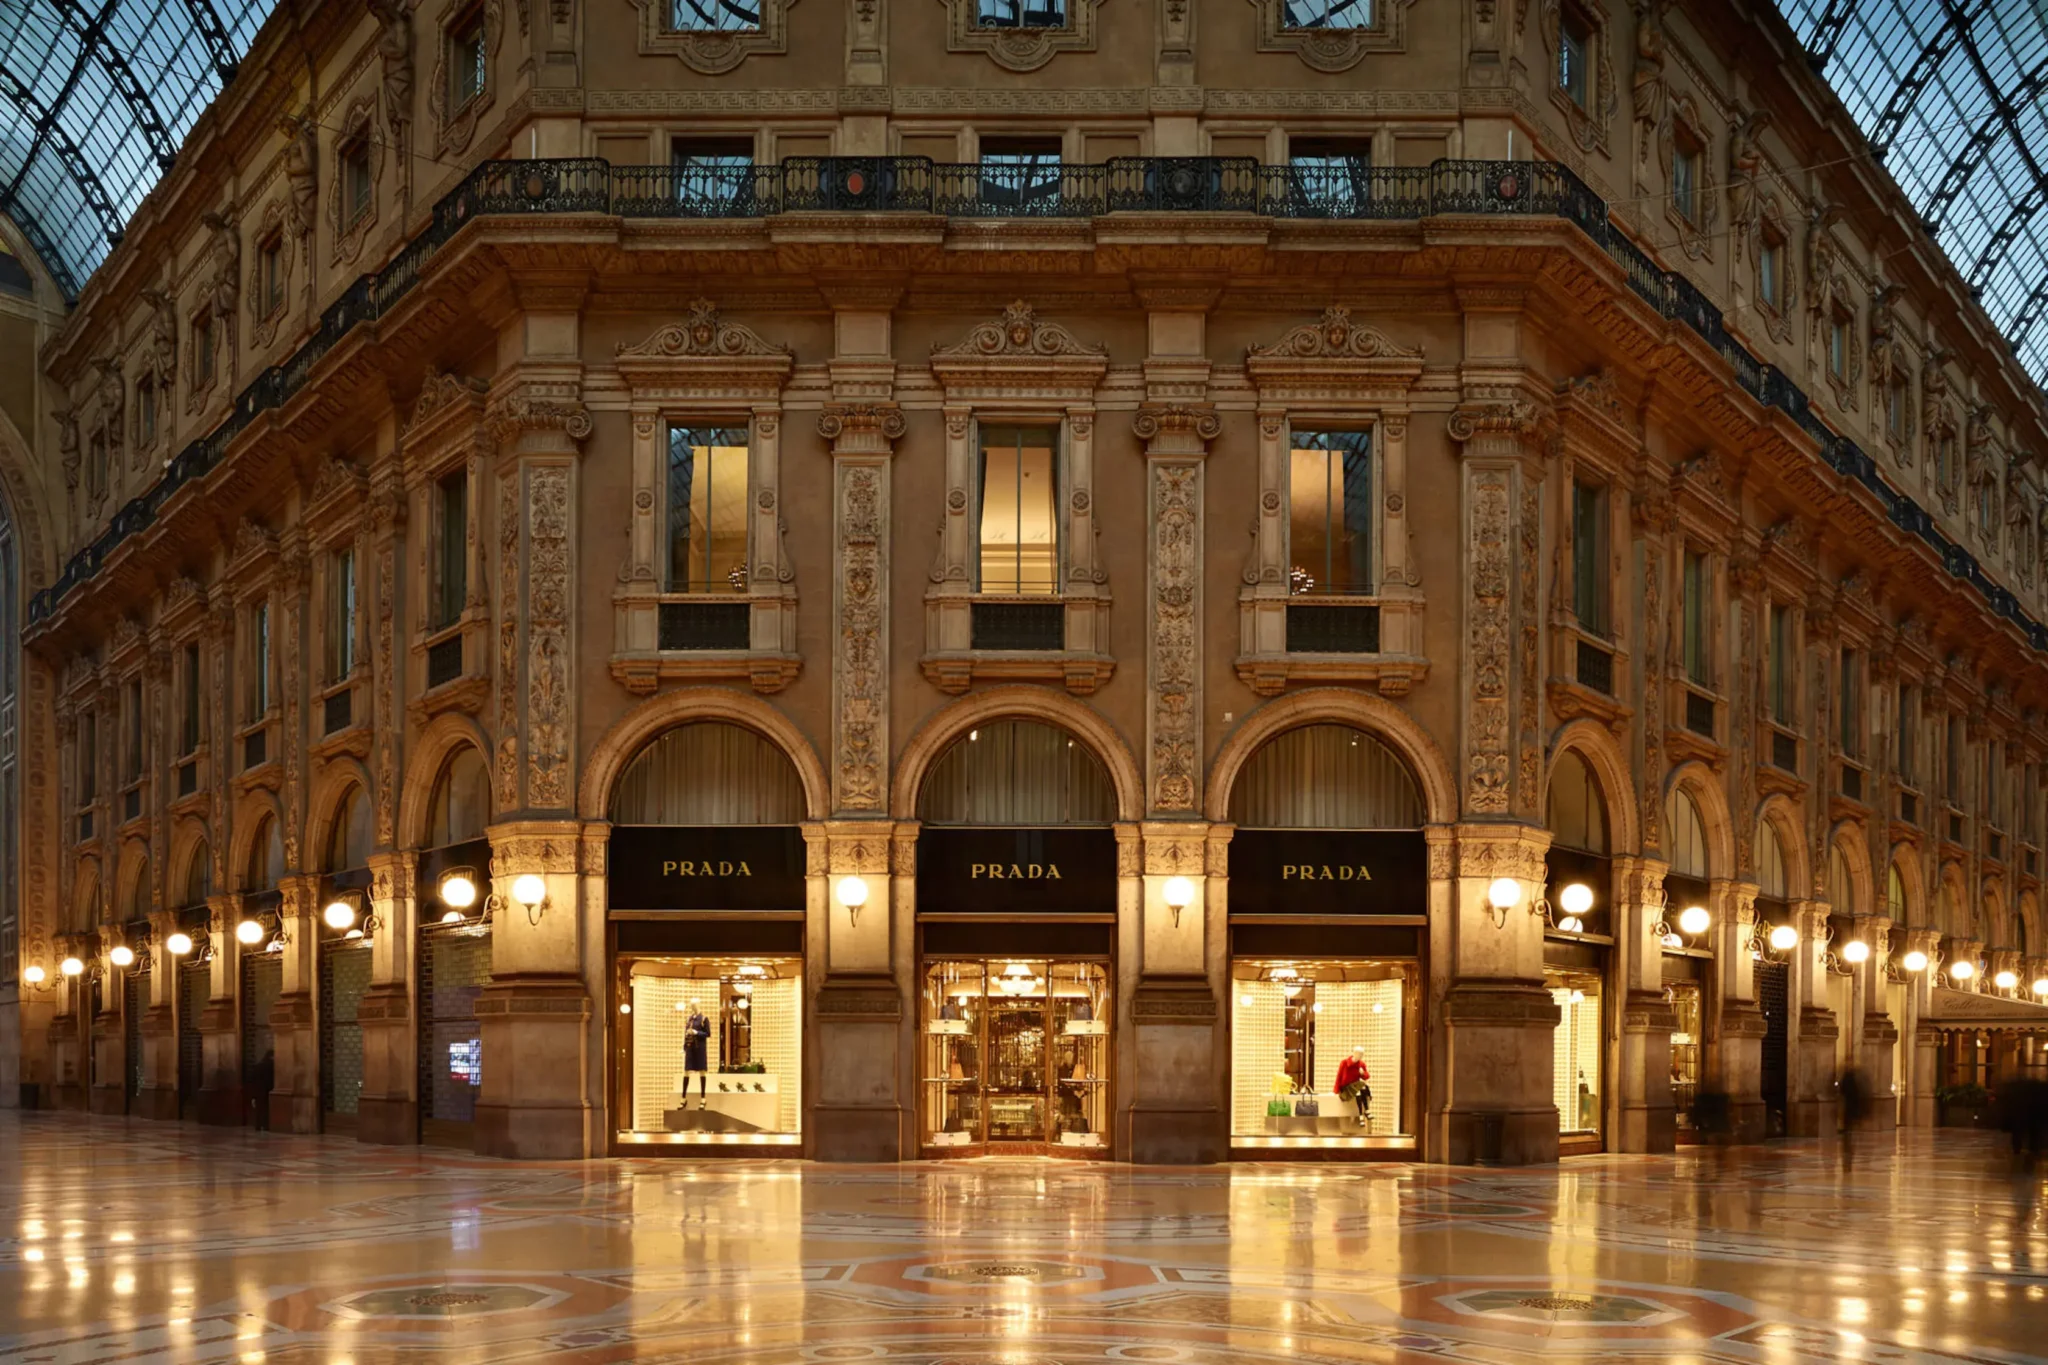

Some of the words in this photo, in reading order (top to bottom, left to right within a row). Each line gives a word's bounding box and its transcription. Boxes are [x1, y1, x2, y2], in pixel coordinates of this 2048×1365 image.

[664, 861, 752, 876] PRADA
[971, 863, 1062, 878] PRADA
[1282, 865, 1372, 880] PRADA
